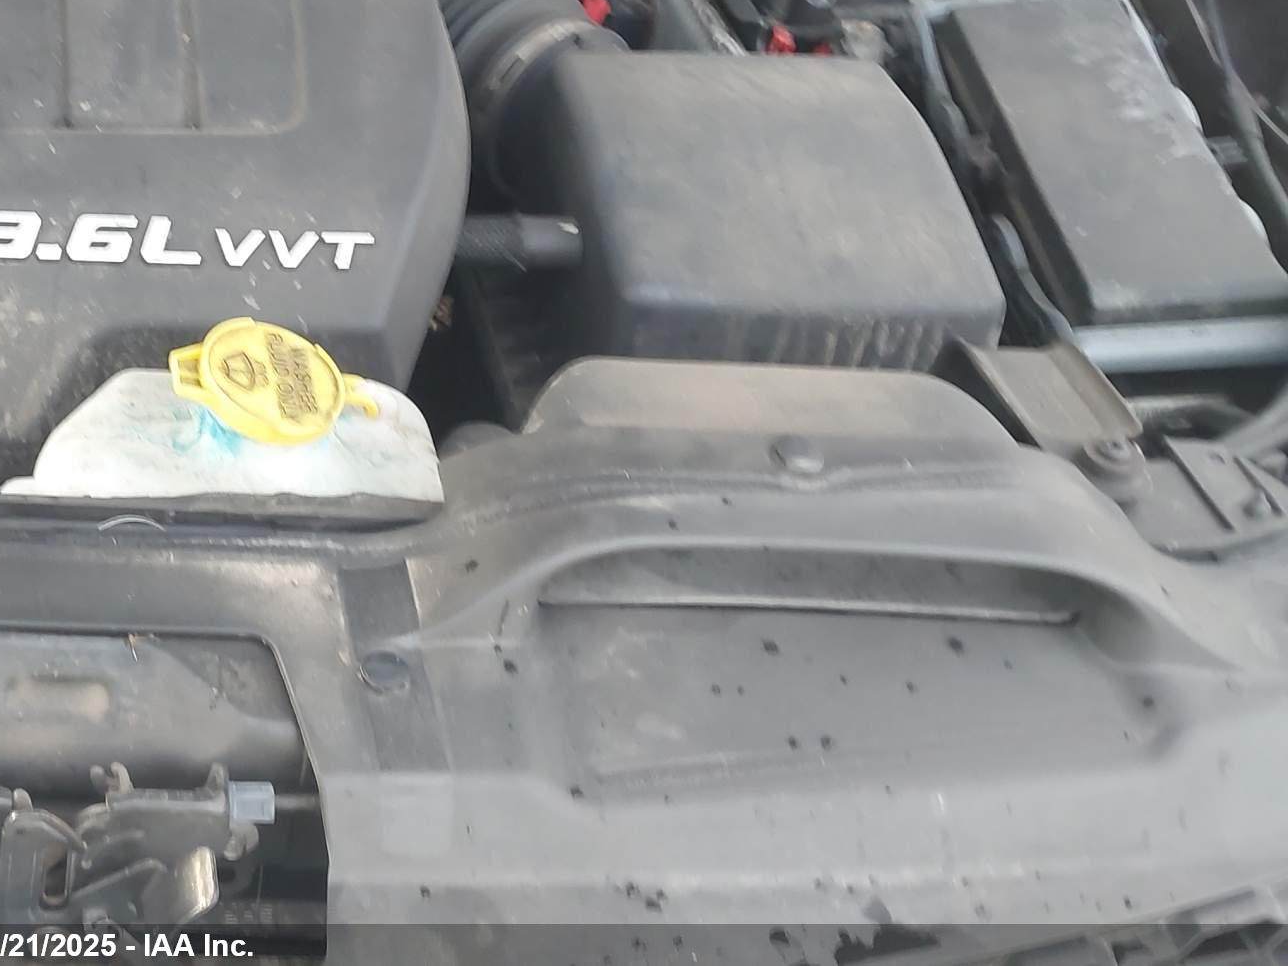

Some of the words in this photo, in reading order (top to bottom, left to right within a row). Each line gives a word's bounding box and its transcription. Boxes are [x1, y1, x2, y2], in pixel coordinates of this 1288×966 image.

[214, 228, 376, 270] VVT
[264, 332, 290, 377] FLUID
[289, 345, 319, 414] WASHER
[276, 381, 301, 423] ONLY
